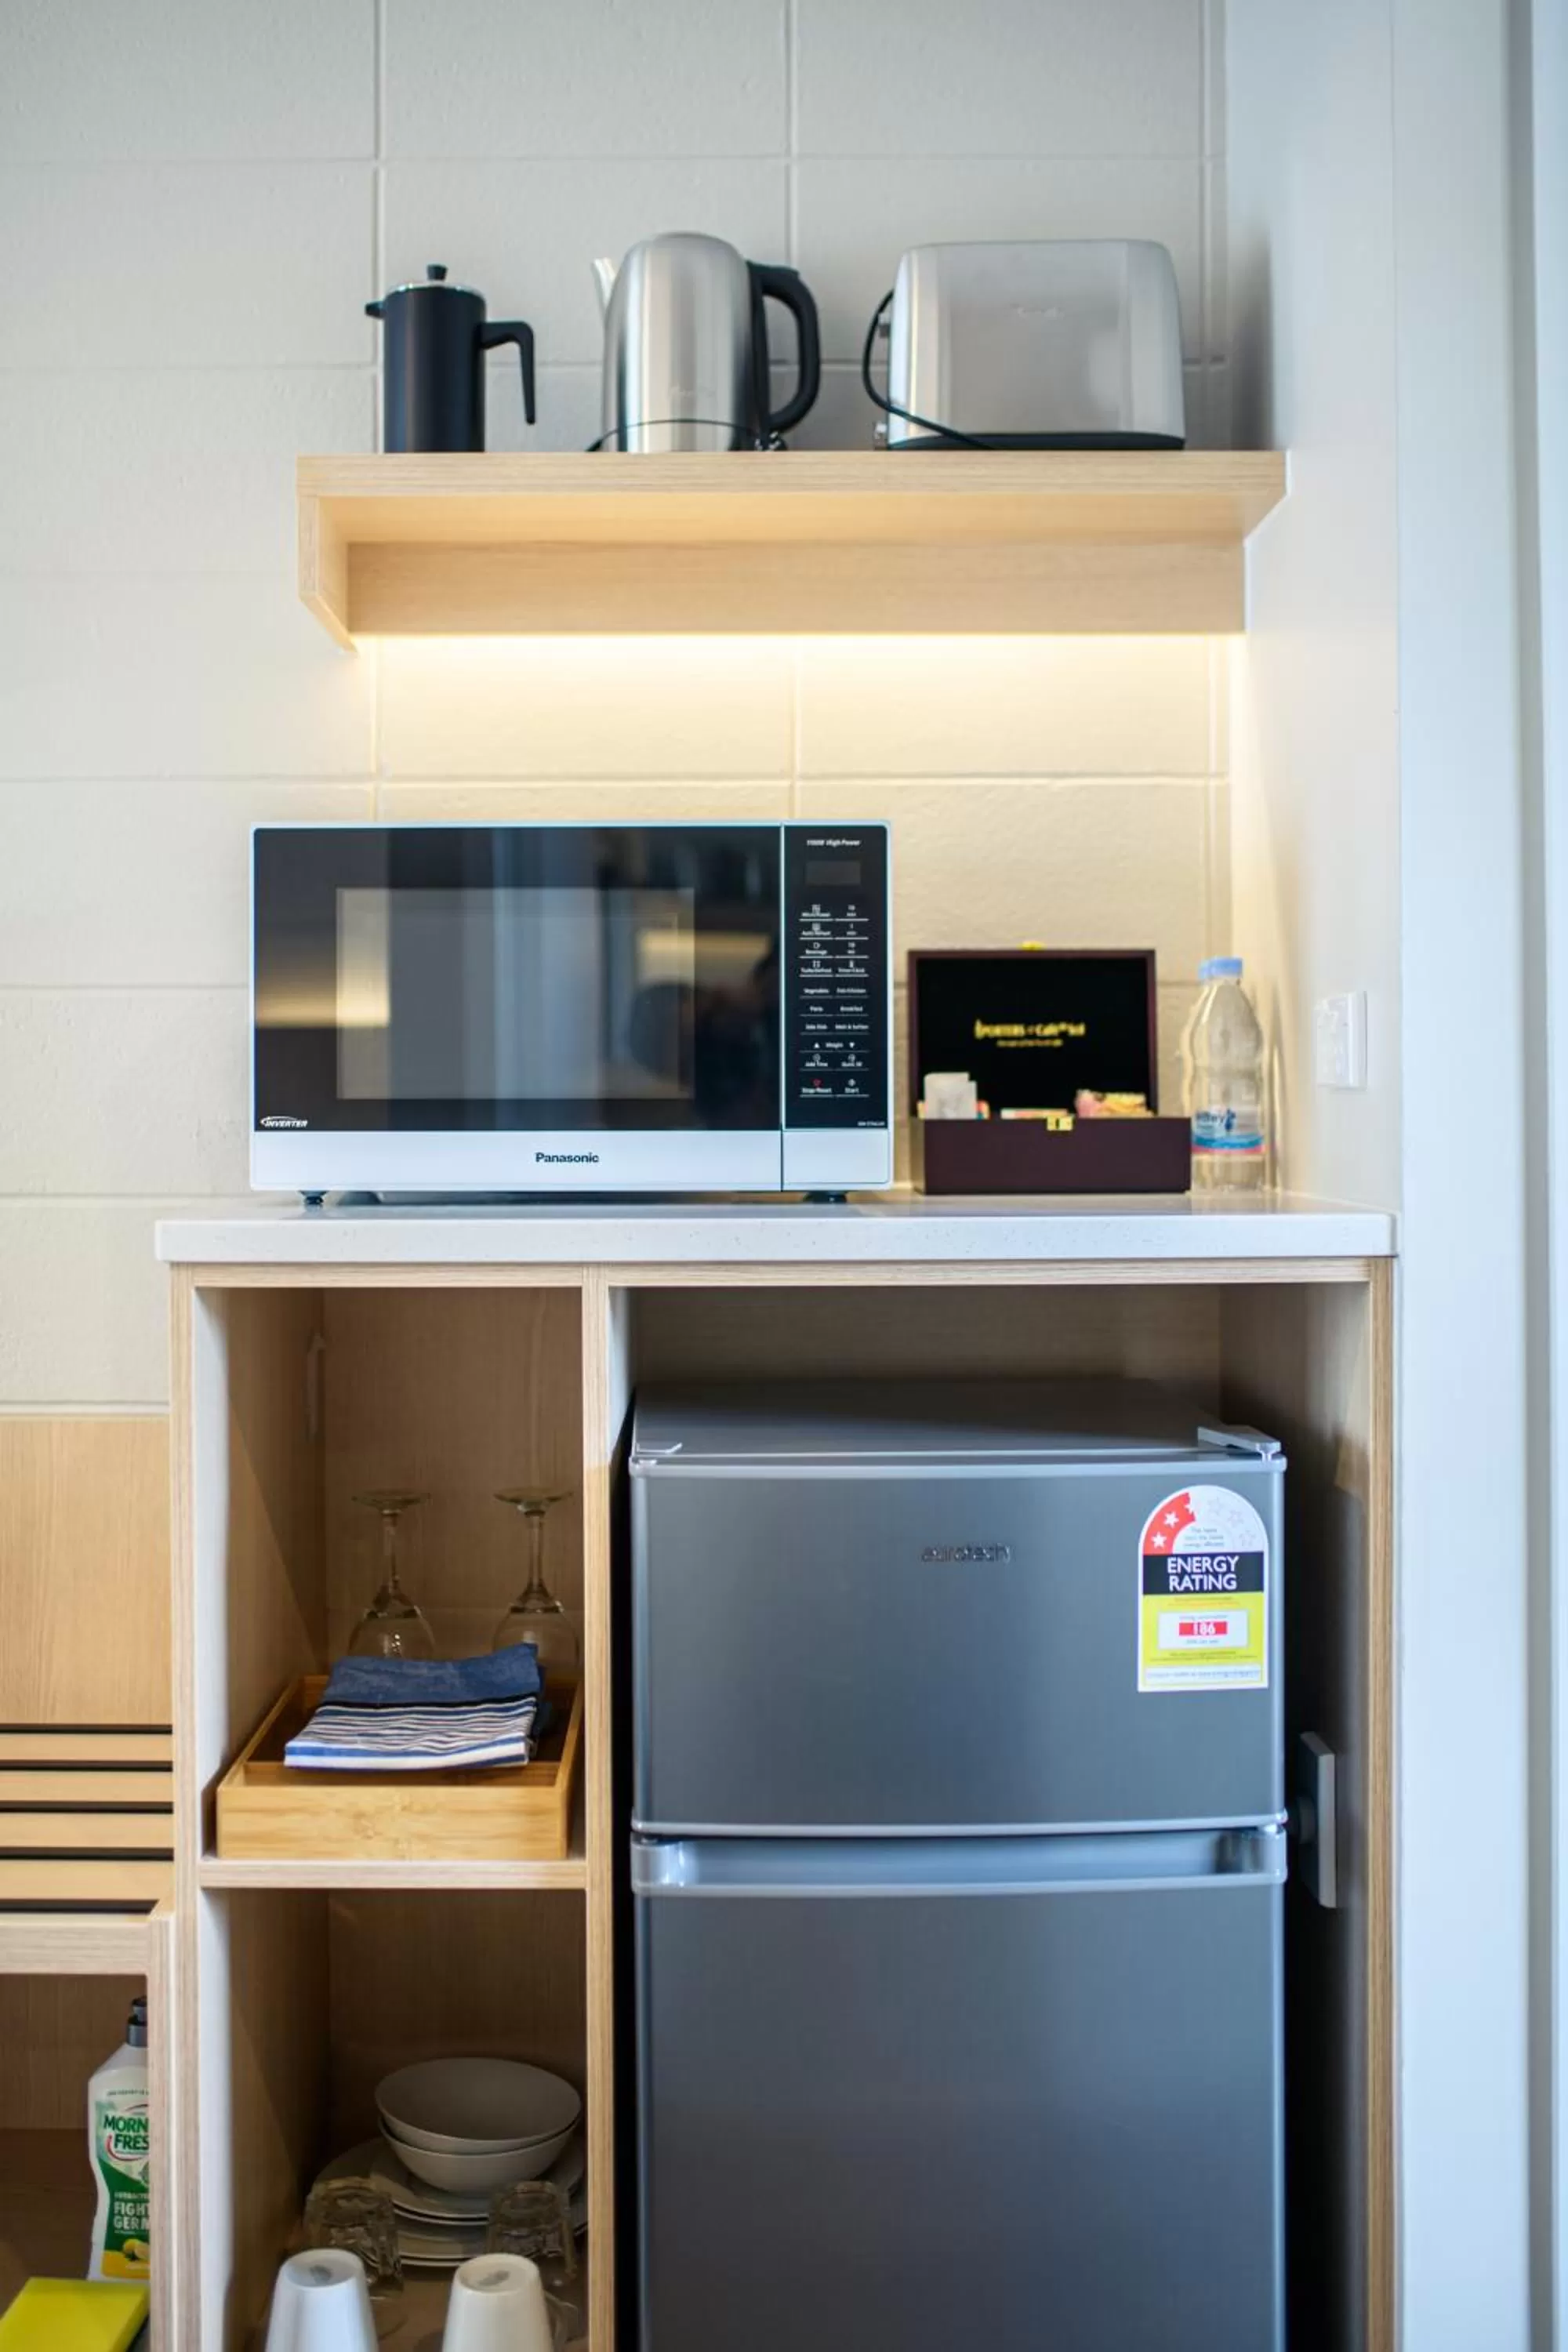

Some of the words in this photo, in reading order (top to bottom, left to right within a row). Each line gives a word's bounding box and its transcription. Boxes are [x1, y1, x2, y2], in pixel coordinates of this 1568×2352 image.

[535, 1151, 600, 1163] Panasonic
[1167, 1555, 1240, 1574] ENERGY
[1169, 1573, 1237, 1592] RATING
[103, 2114, 149, 2133] MORN
